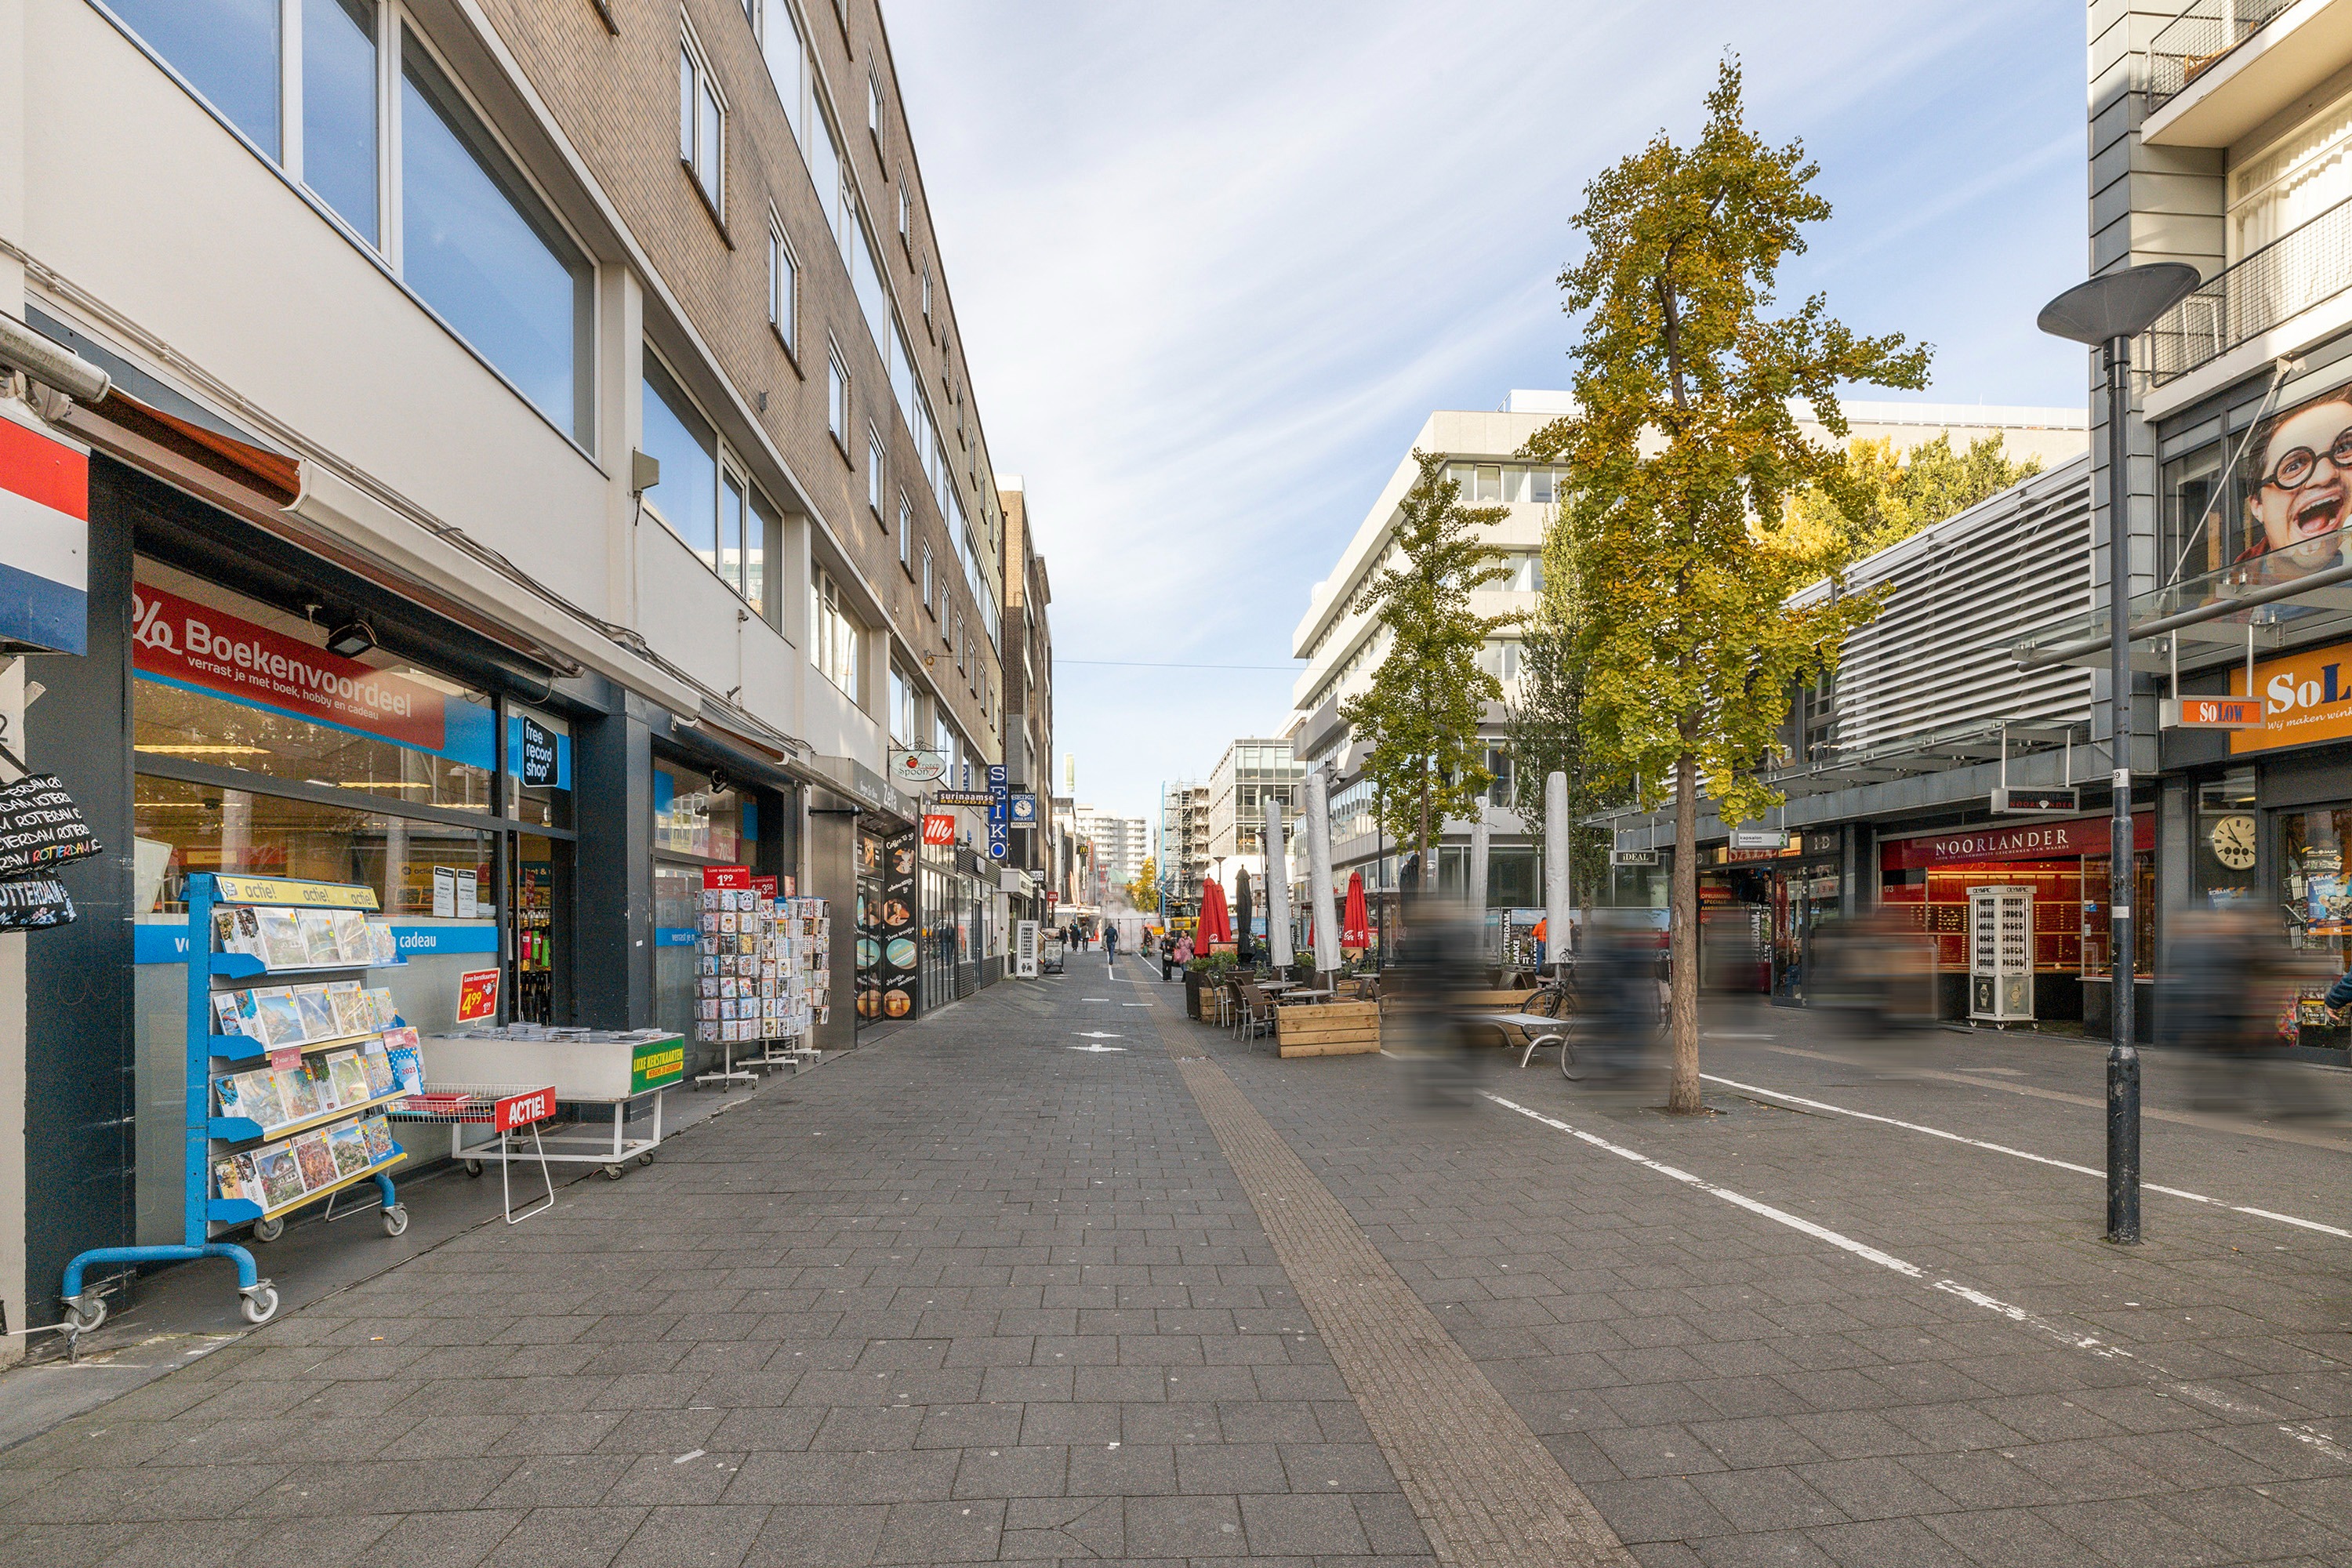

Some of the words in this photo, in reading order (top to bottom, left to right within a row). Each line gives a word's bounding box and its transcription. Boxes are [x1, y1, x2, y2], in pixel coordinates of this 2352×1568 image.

[185, 619, 412, 718] Boekenvoordeel
[187, 656, 232, 678] verrast
[234, 666, 245, 682] je
[249, 673, 270, 689] met
[273, 680, 300, 699] boek,
[303, 684, 332, 708] hobby
[334, 700, 346, 711] en
[348, 703, 378, 720] cadeau
[526, 720, 543, 745] free
[2267, 719, 2285, 731] Wij
[2286, 714, 2325, 727] maken
[526, 743, 552, 762] record
[526, 759, 547, 782] shop
[898, 768, 929, 777] Spoon
[941, 792, 994, 801] surinaamse
[15, 808, 74, 827] ROTTERDAM
[990, 767, 1006, 858] SEIKO
[926, 819, 953, 842] illy
[33, 840, 89, 863] ROTTERDAM
[1936, 829, 2068, 856] NOORLANDER
[1623, 852, 1649, 861] iDEAL
[245, 883, 277, 900] actie!
[303, 887, 328, 902] actie!
[350, 891, 375, 906] actie!
[399, 931, 437, 948] cadeau
[686, 931, 691, 944] je
[401, 1066, 416, 1075] 2023
[633, 1057, 647, 1073] LUXE
[647, 1047, 684, 1069] KERSTKAARTEN
[508, 1094, 546, 1125] ACTIE!
